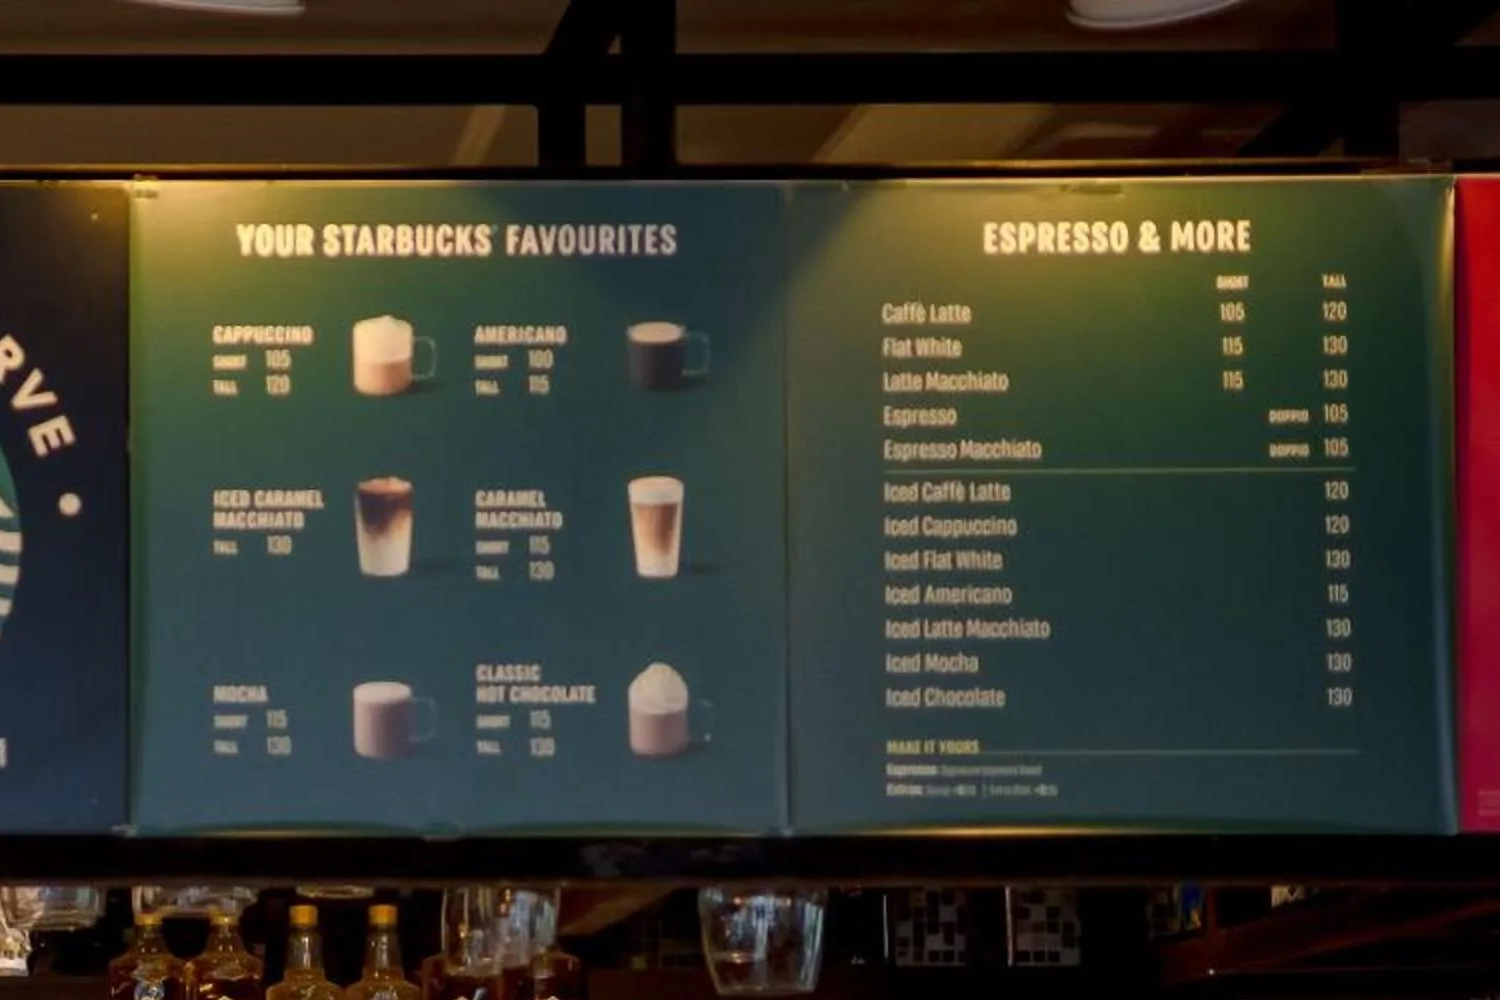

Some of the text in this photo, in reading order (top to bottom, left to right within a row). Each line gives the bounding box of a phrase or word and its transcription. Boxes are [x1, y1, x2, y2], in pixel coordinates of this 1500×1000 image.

[237, 223, 677, 257] YOUR STARBUCKS FAVOURITES
[983, 219, 1251, 254] ESPRESSO & MORE
[881, 301, 972, 325] Caffè Latte
[1219, 301, 1246, 322] 105
[1322, 300, 1348, 321] 120
[212, 325, 313, 345] CAPPUCCINO
[474, 325, 567, 344] AMERICANO
[882, 337, 963, 359] Flat White
[1222, 336, 1244, 356] 115
[1322, 335, 1348, 356] 130
[883, 370, 1010, 393] Latte Macchiato
[1222, 370, 1244, 390] 115
[1323, 369, 1349, 389] 130
[883, 405, 958, 429] Espresso
[1323, 403, 1349, 423] 105
[883, 438, 1043, 463] Espresso Macchiato
[1323, 437, 1349, 457] 105
[213, 489, 324, 509] ICED CARAMEL
[475, 490, 546, 508] CARAMEL
[883, 480, 1012, 503] Iced Caffè Latte
[1324, 480, 1350, 501] 120
[884, 515, 1018, 539] Iced Cappuccino
[1324, 514, 1350, 535] 120
[884, 549, 1004, 571] Iced Flat White
[1325, 549, 1351, 569] 130
[884, 584, 1013, 606] Iced Americano
[1327, 583, 1349, 604] 115
[885, 617, 1051, 640] Iced Latte Macchiato
[1326, 617, 1352, 638] 130
[476, 664, 540, 682] CLASSIC
[885, 651, 979, 674] Iced Mocha
[1326, 652, 1353, 673] 130
[509, 685, 595, 703] CHOCOLATE
[885, 686, 1006, 708] Iced Chocolate
[1327, 686, 1353, 707] 130
